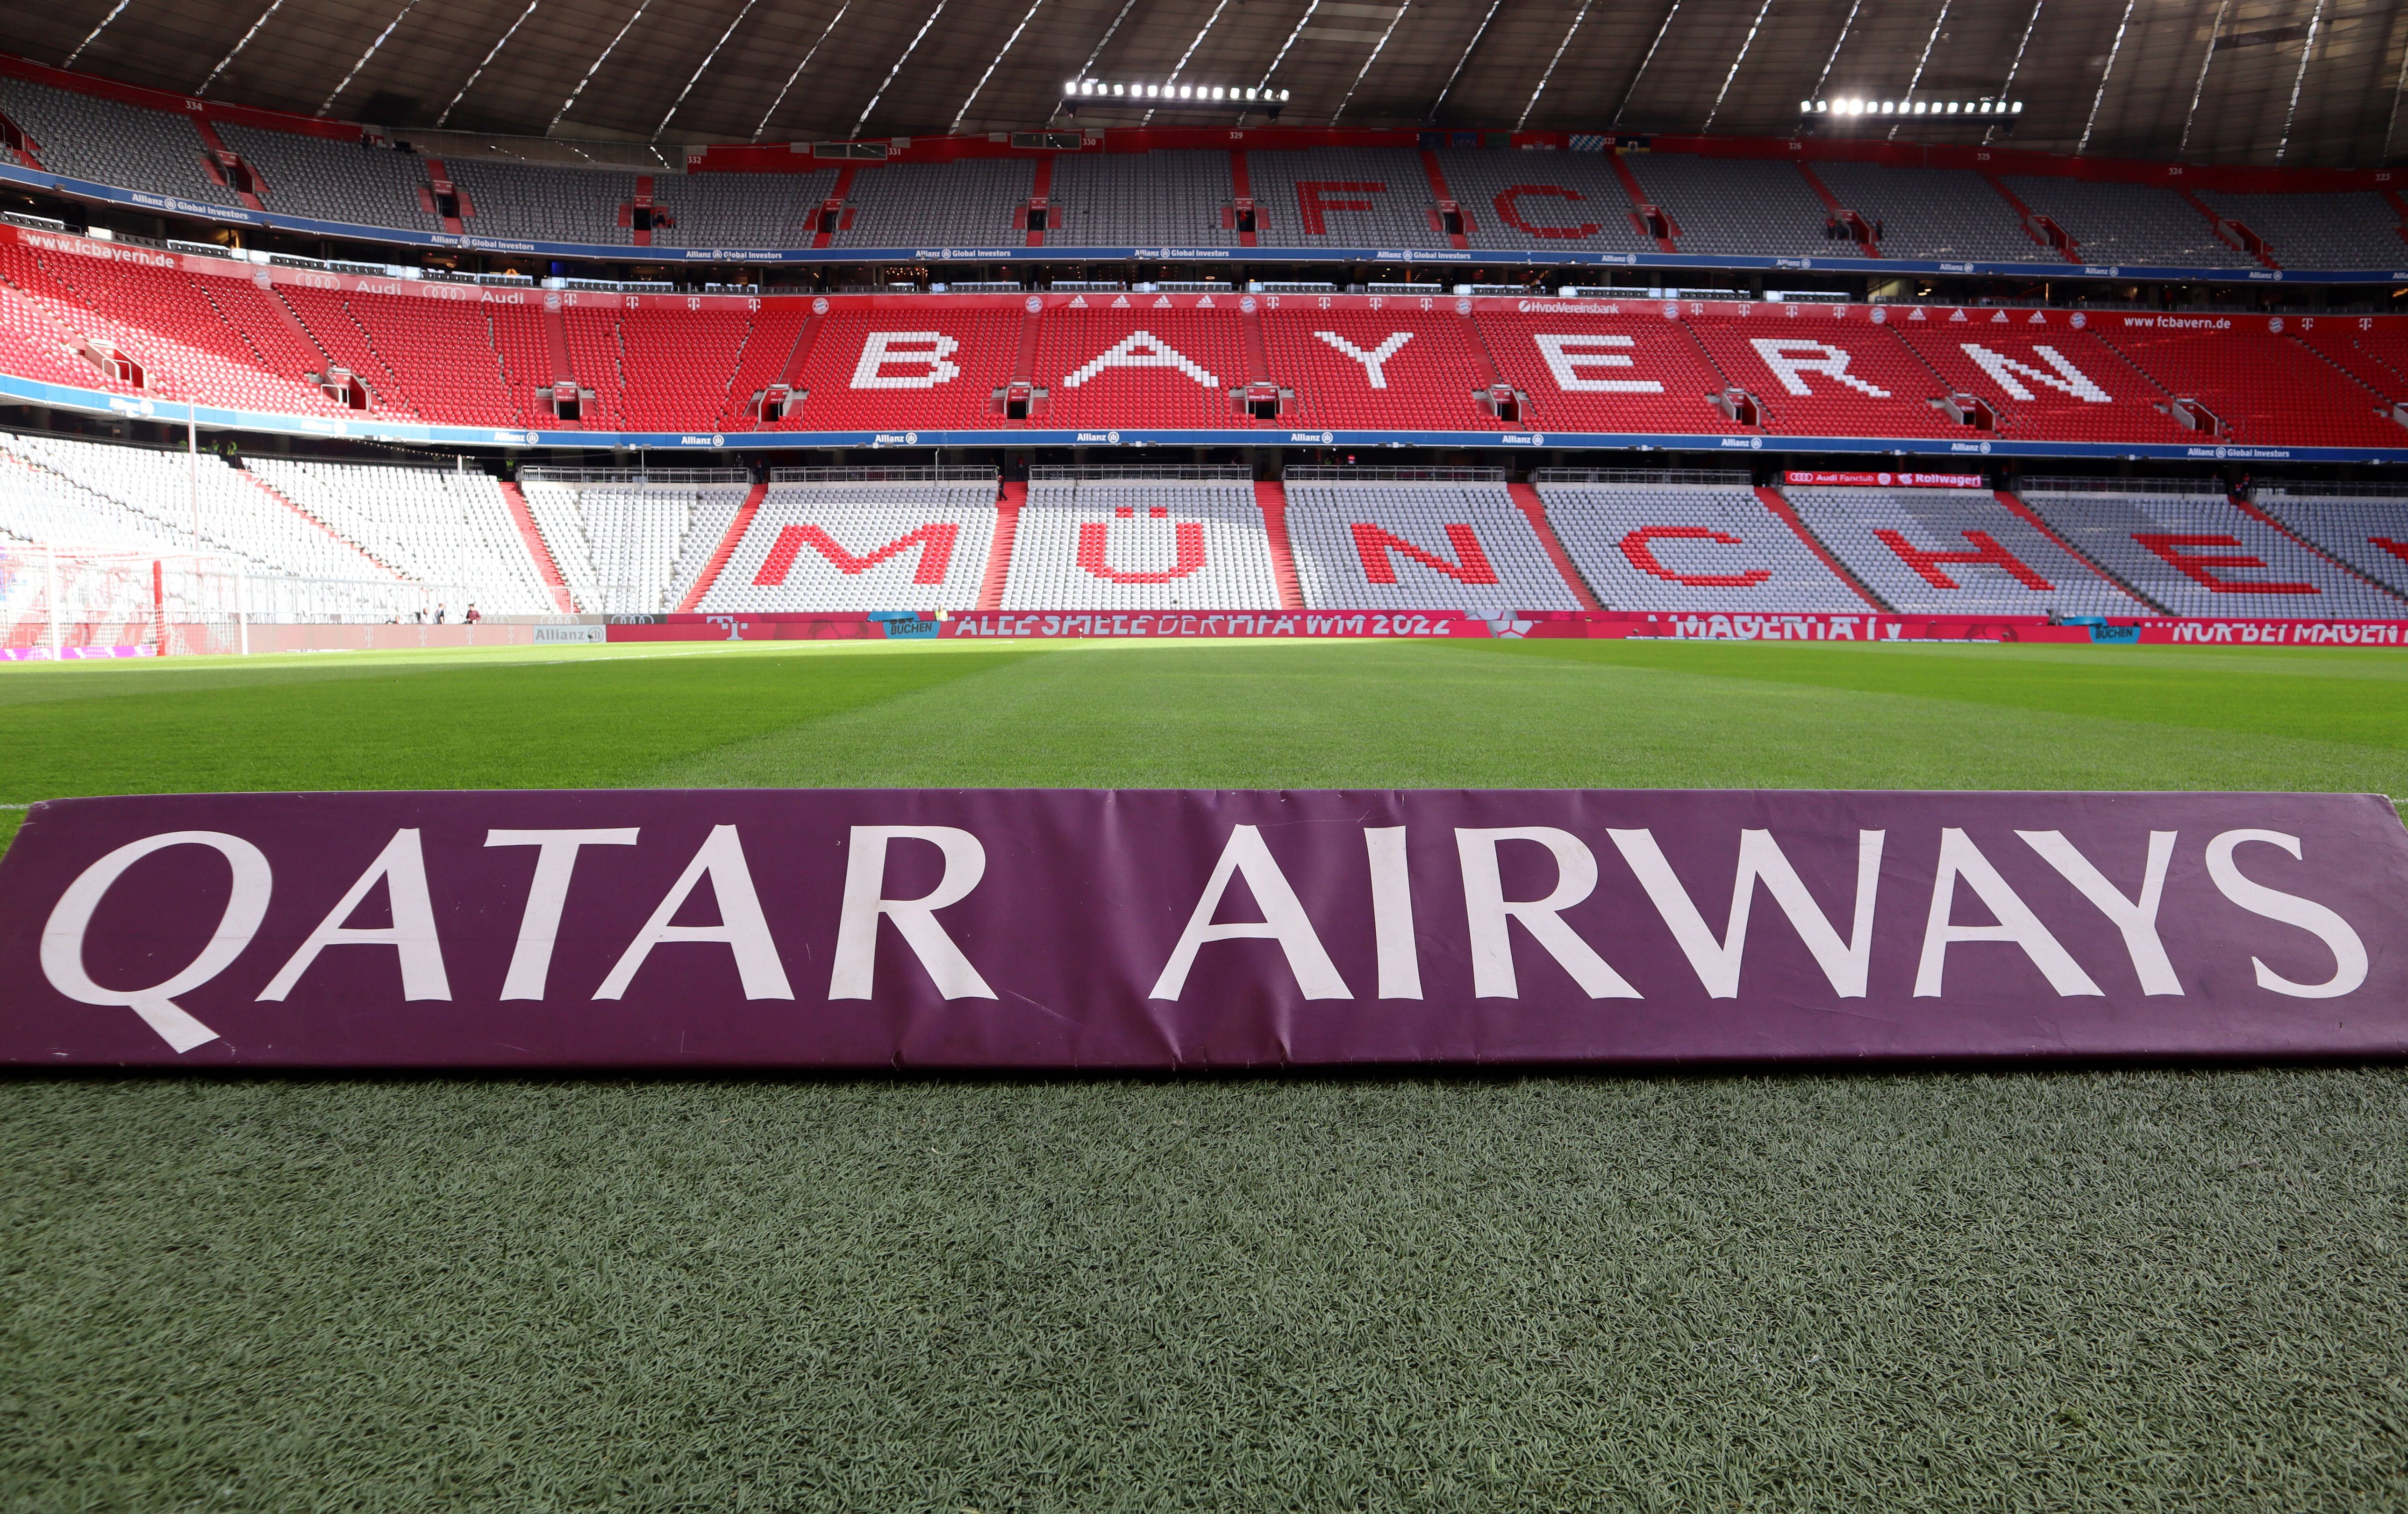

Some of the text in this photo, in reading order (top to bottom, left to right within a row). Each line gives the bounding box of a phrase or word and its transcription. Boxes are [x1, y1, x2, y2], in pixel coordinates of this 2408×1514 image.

[186, 100, 202, 111] 334
[687, 156, 701, 164] 332
[132, 193, 250, 221] Allianz Global Investors
[431, 235, 535, 250] Allianz Global Investors
[26, 232, 175, 269] www.fcbayern.de
[1601, 254, 1626, 263] Allianz
[356, 280, 402, 296] Audi
[481, 291, 524, 305] Audi
[2124, 316, 2231, 329] wwwfcbayern.de
[494, 431, 525, 442] Allianz
[681, 435, 711, 445] Allianz
[875, 433, 904, 443] Allianz
[1077, 432, 1107, 442] Allianz
[1291, 432, 1320, 442] Allianz
[1502, 435, 1531, 444] Allianz
[1721, 438, 1750, 447] Allianz
[1951, 442, 1979, 452] Allianz
[2187, 447, 2290, 458] Allianz Global Investors
[891, 622, 932, 635] BUCHEN
[2293, 624, 2408, 644] MAGEN
[535, 629, 585, 641] Allianz
[38, 823, 2369, 1054] QATAR AIRWAYS
